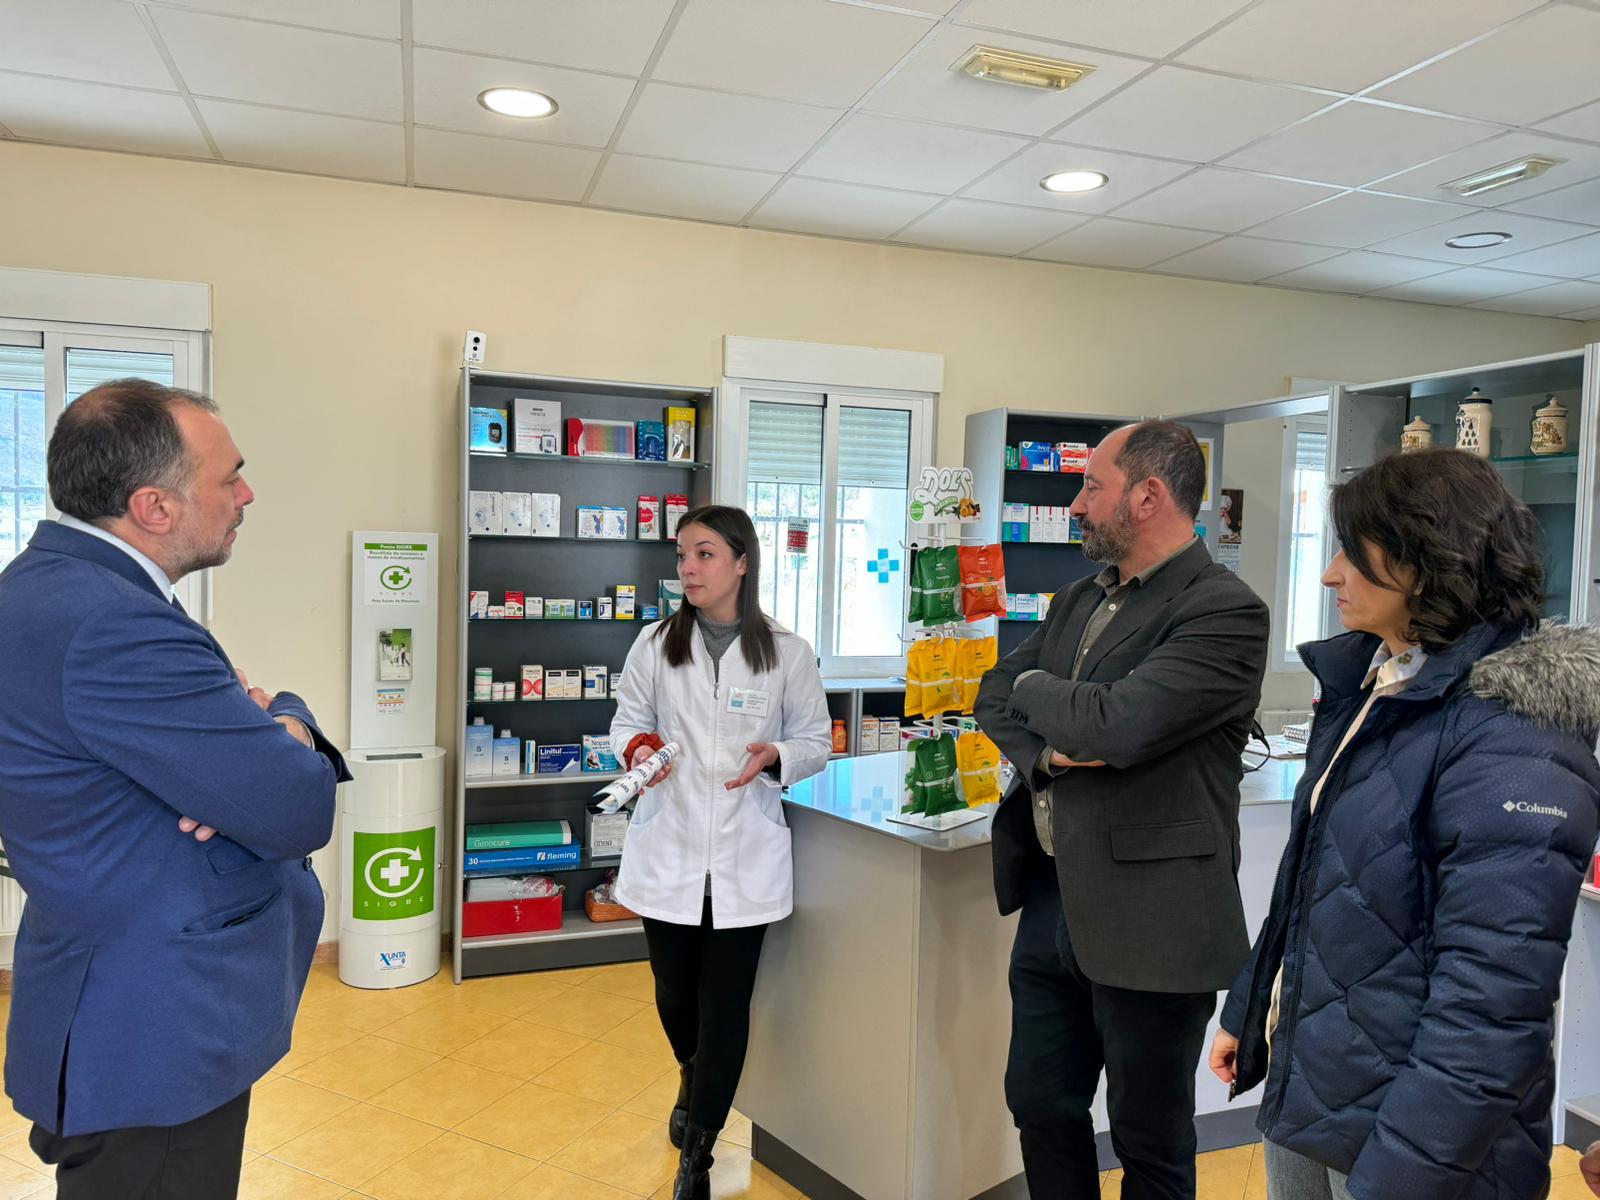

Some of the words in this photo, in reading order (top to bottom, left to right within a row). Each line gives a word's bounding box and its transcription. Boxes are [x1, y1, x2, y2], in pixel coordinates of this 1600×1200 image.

[1516, 801, 1568, 818] Columbia
[473, 839, 511, 848] Genocure
[547, 852, 576, 860] fleming
[364, 896, 424, 907] SIGRE
[380, 952, 406, 966] XUNTA
